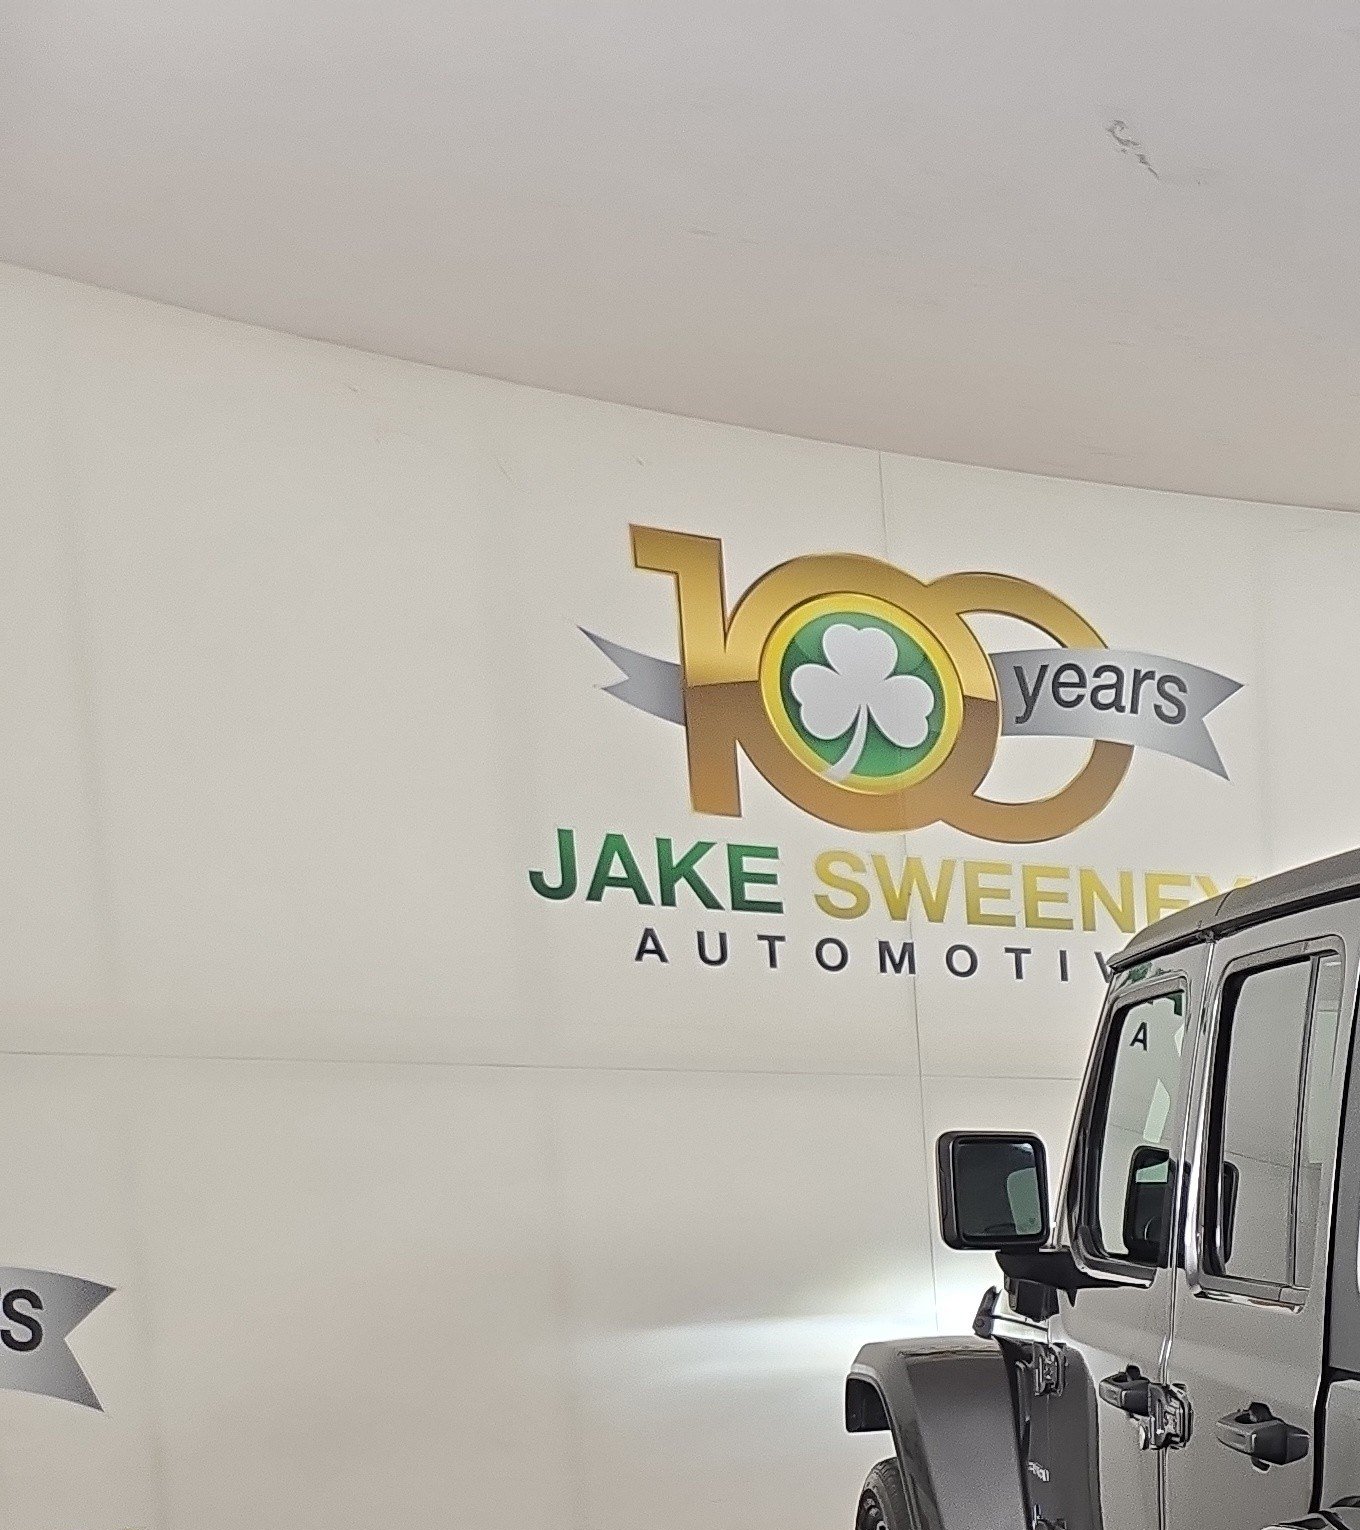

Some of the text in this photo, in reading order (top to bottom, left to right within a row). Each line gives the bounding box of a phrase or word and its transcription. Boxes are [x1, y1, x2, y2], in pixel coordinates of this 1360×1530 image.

[1011, 659, 1190, 726] years
[527, 827, 785, 915] JAKE
[634, 926, 1110, 982] AUTOMOTI
